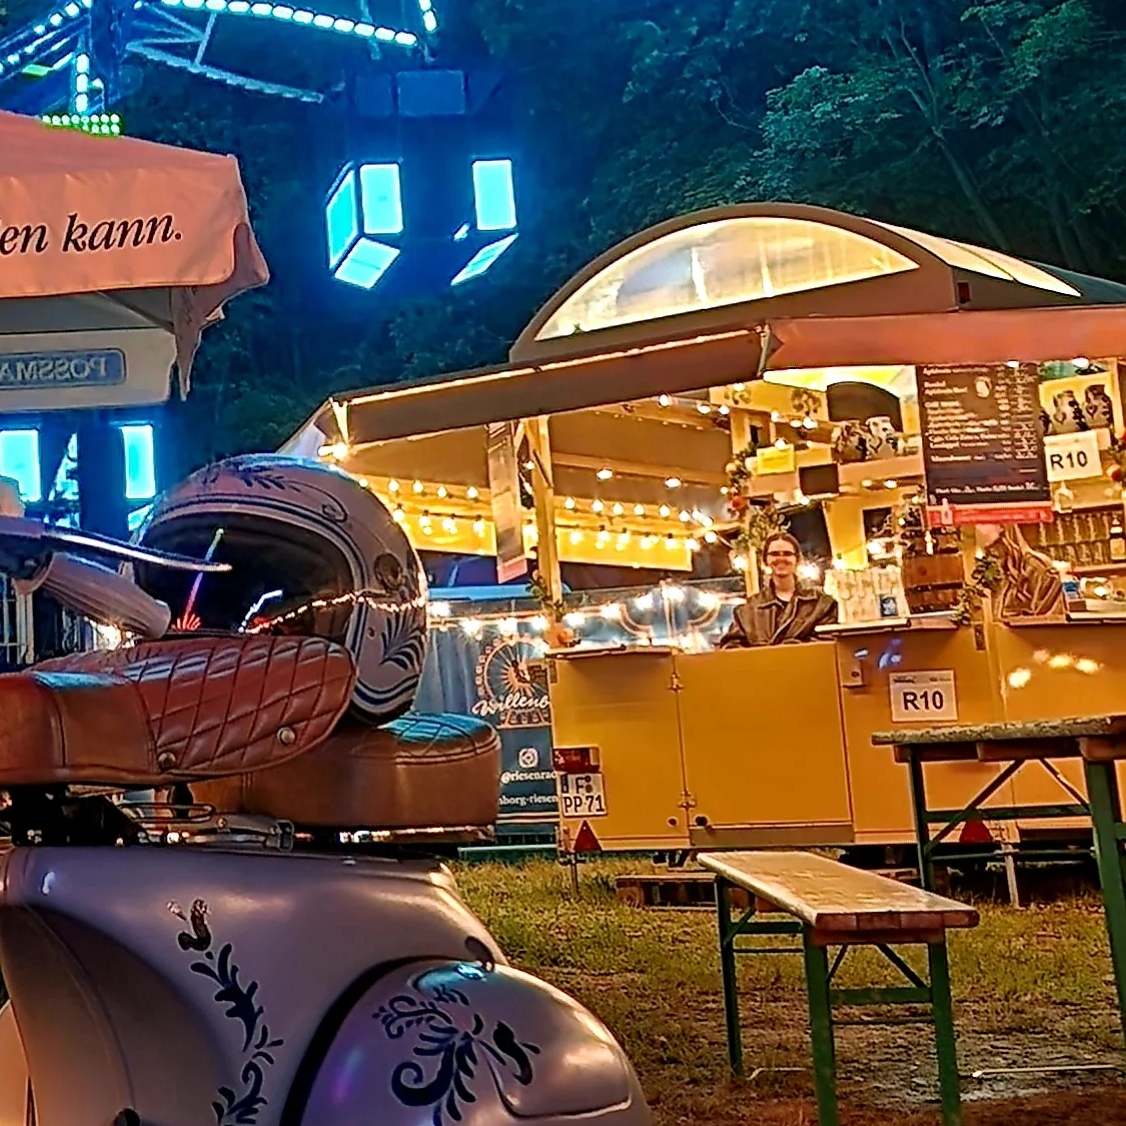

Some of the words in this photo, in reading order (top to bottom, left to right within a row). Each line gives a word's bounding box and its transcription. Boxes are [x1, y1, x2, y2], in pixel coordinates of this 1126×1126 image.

[62, 212, 183, 254] kann.
[1050, 450, 1088, 470] R10
[902, 690, 944, 711] R10
